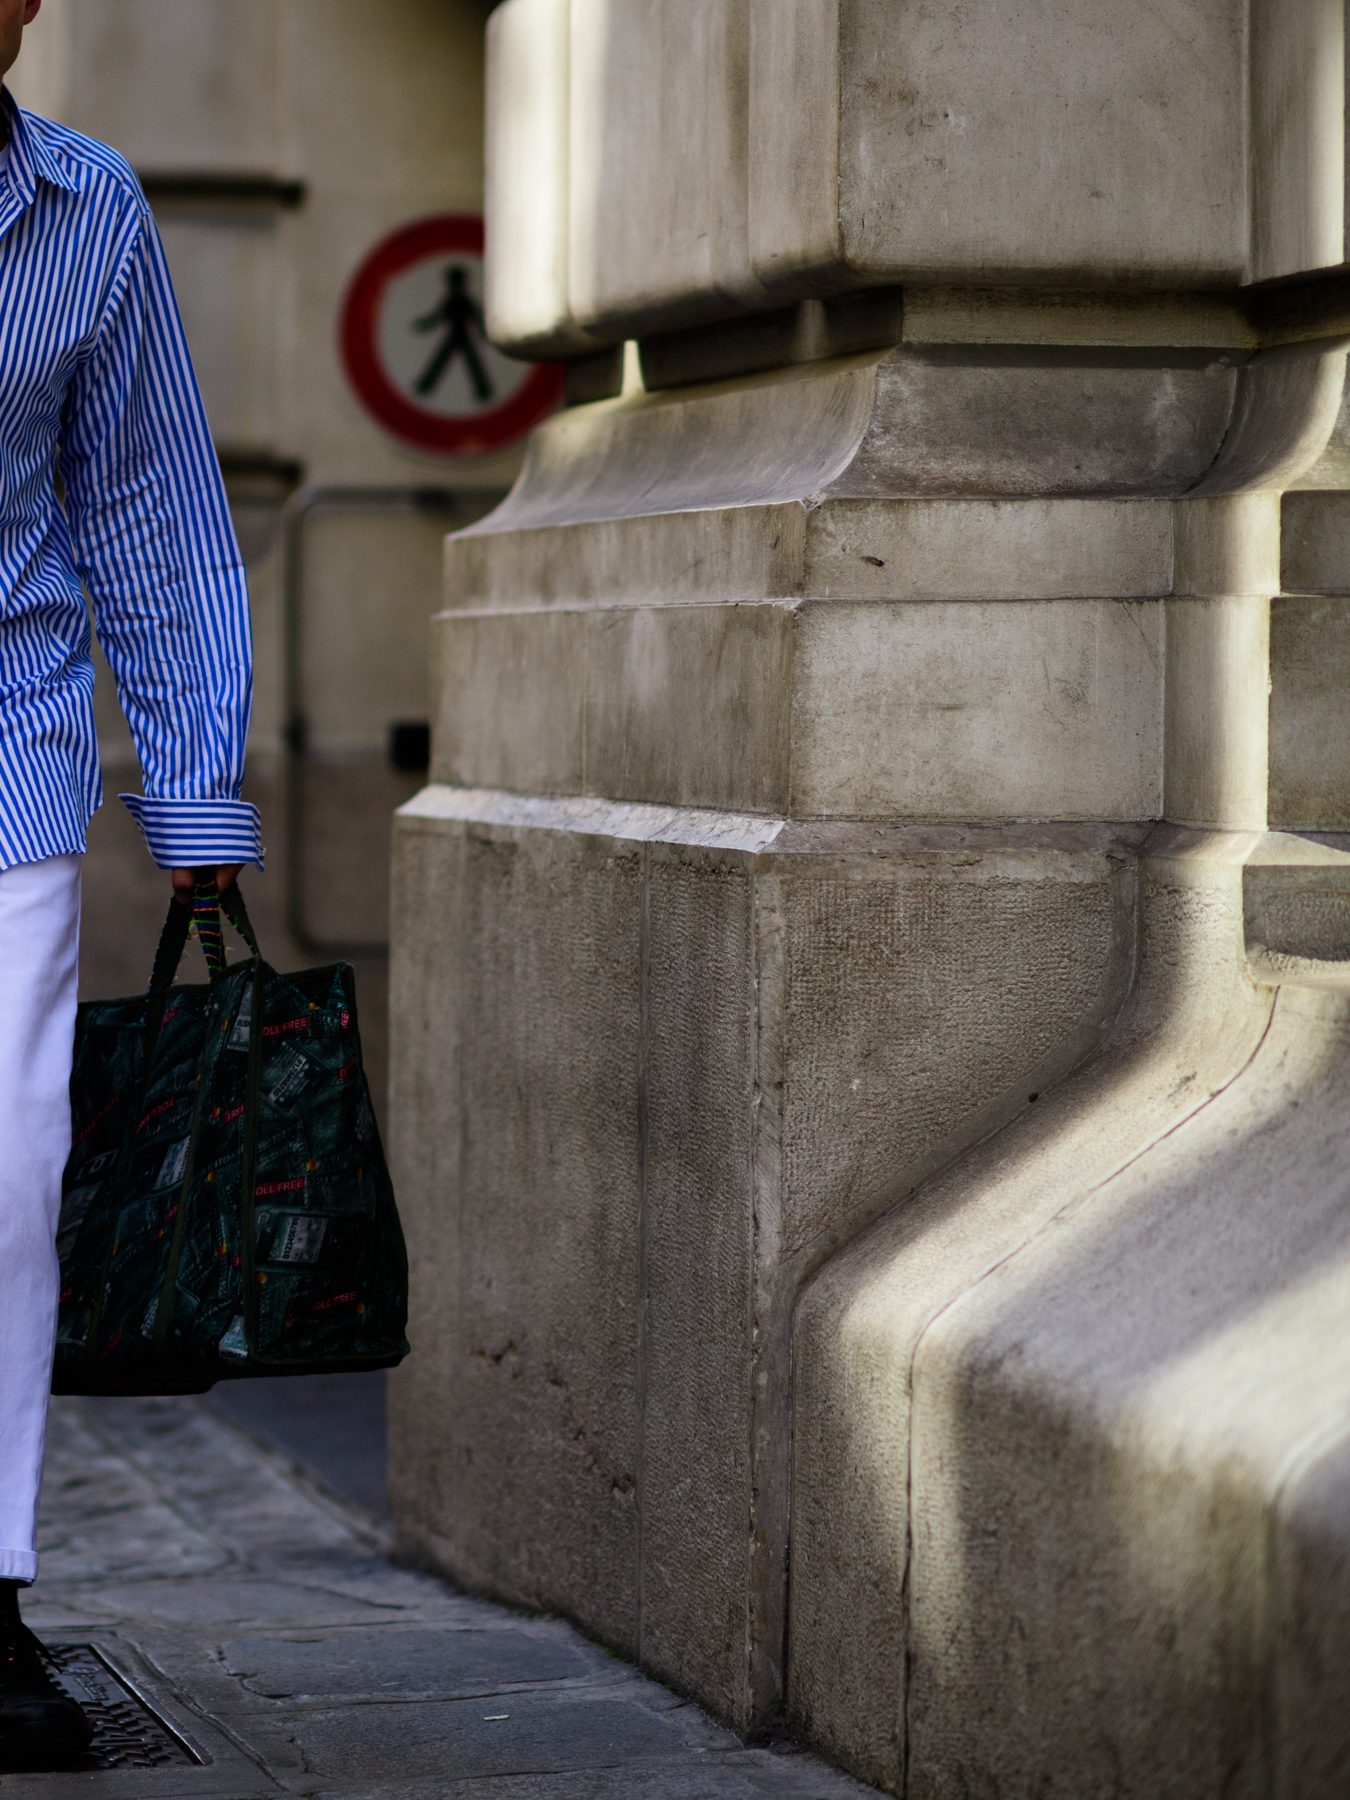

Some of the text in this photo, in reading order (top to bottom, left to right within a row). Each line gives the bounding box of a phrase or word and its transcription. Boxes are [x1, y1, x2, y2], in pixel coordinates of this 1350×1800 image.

[263, 1017, 308, 1036] OLL FREE
[273, 1058, 303, 1097] 0123456789
[149, 1098, 175, 1117] TOLL
[225, 1103, 245, 1122] FREE
[255, 1179, 305, 1196] OLL FREE
[282, 1217, 300, 1259] 0123456789
[334, 1291, 357, 1304] FREE
